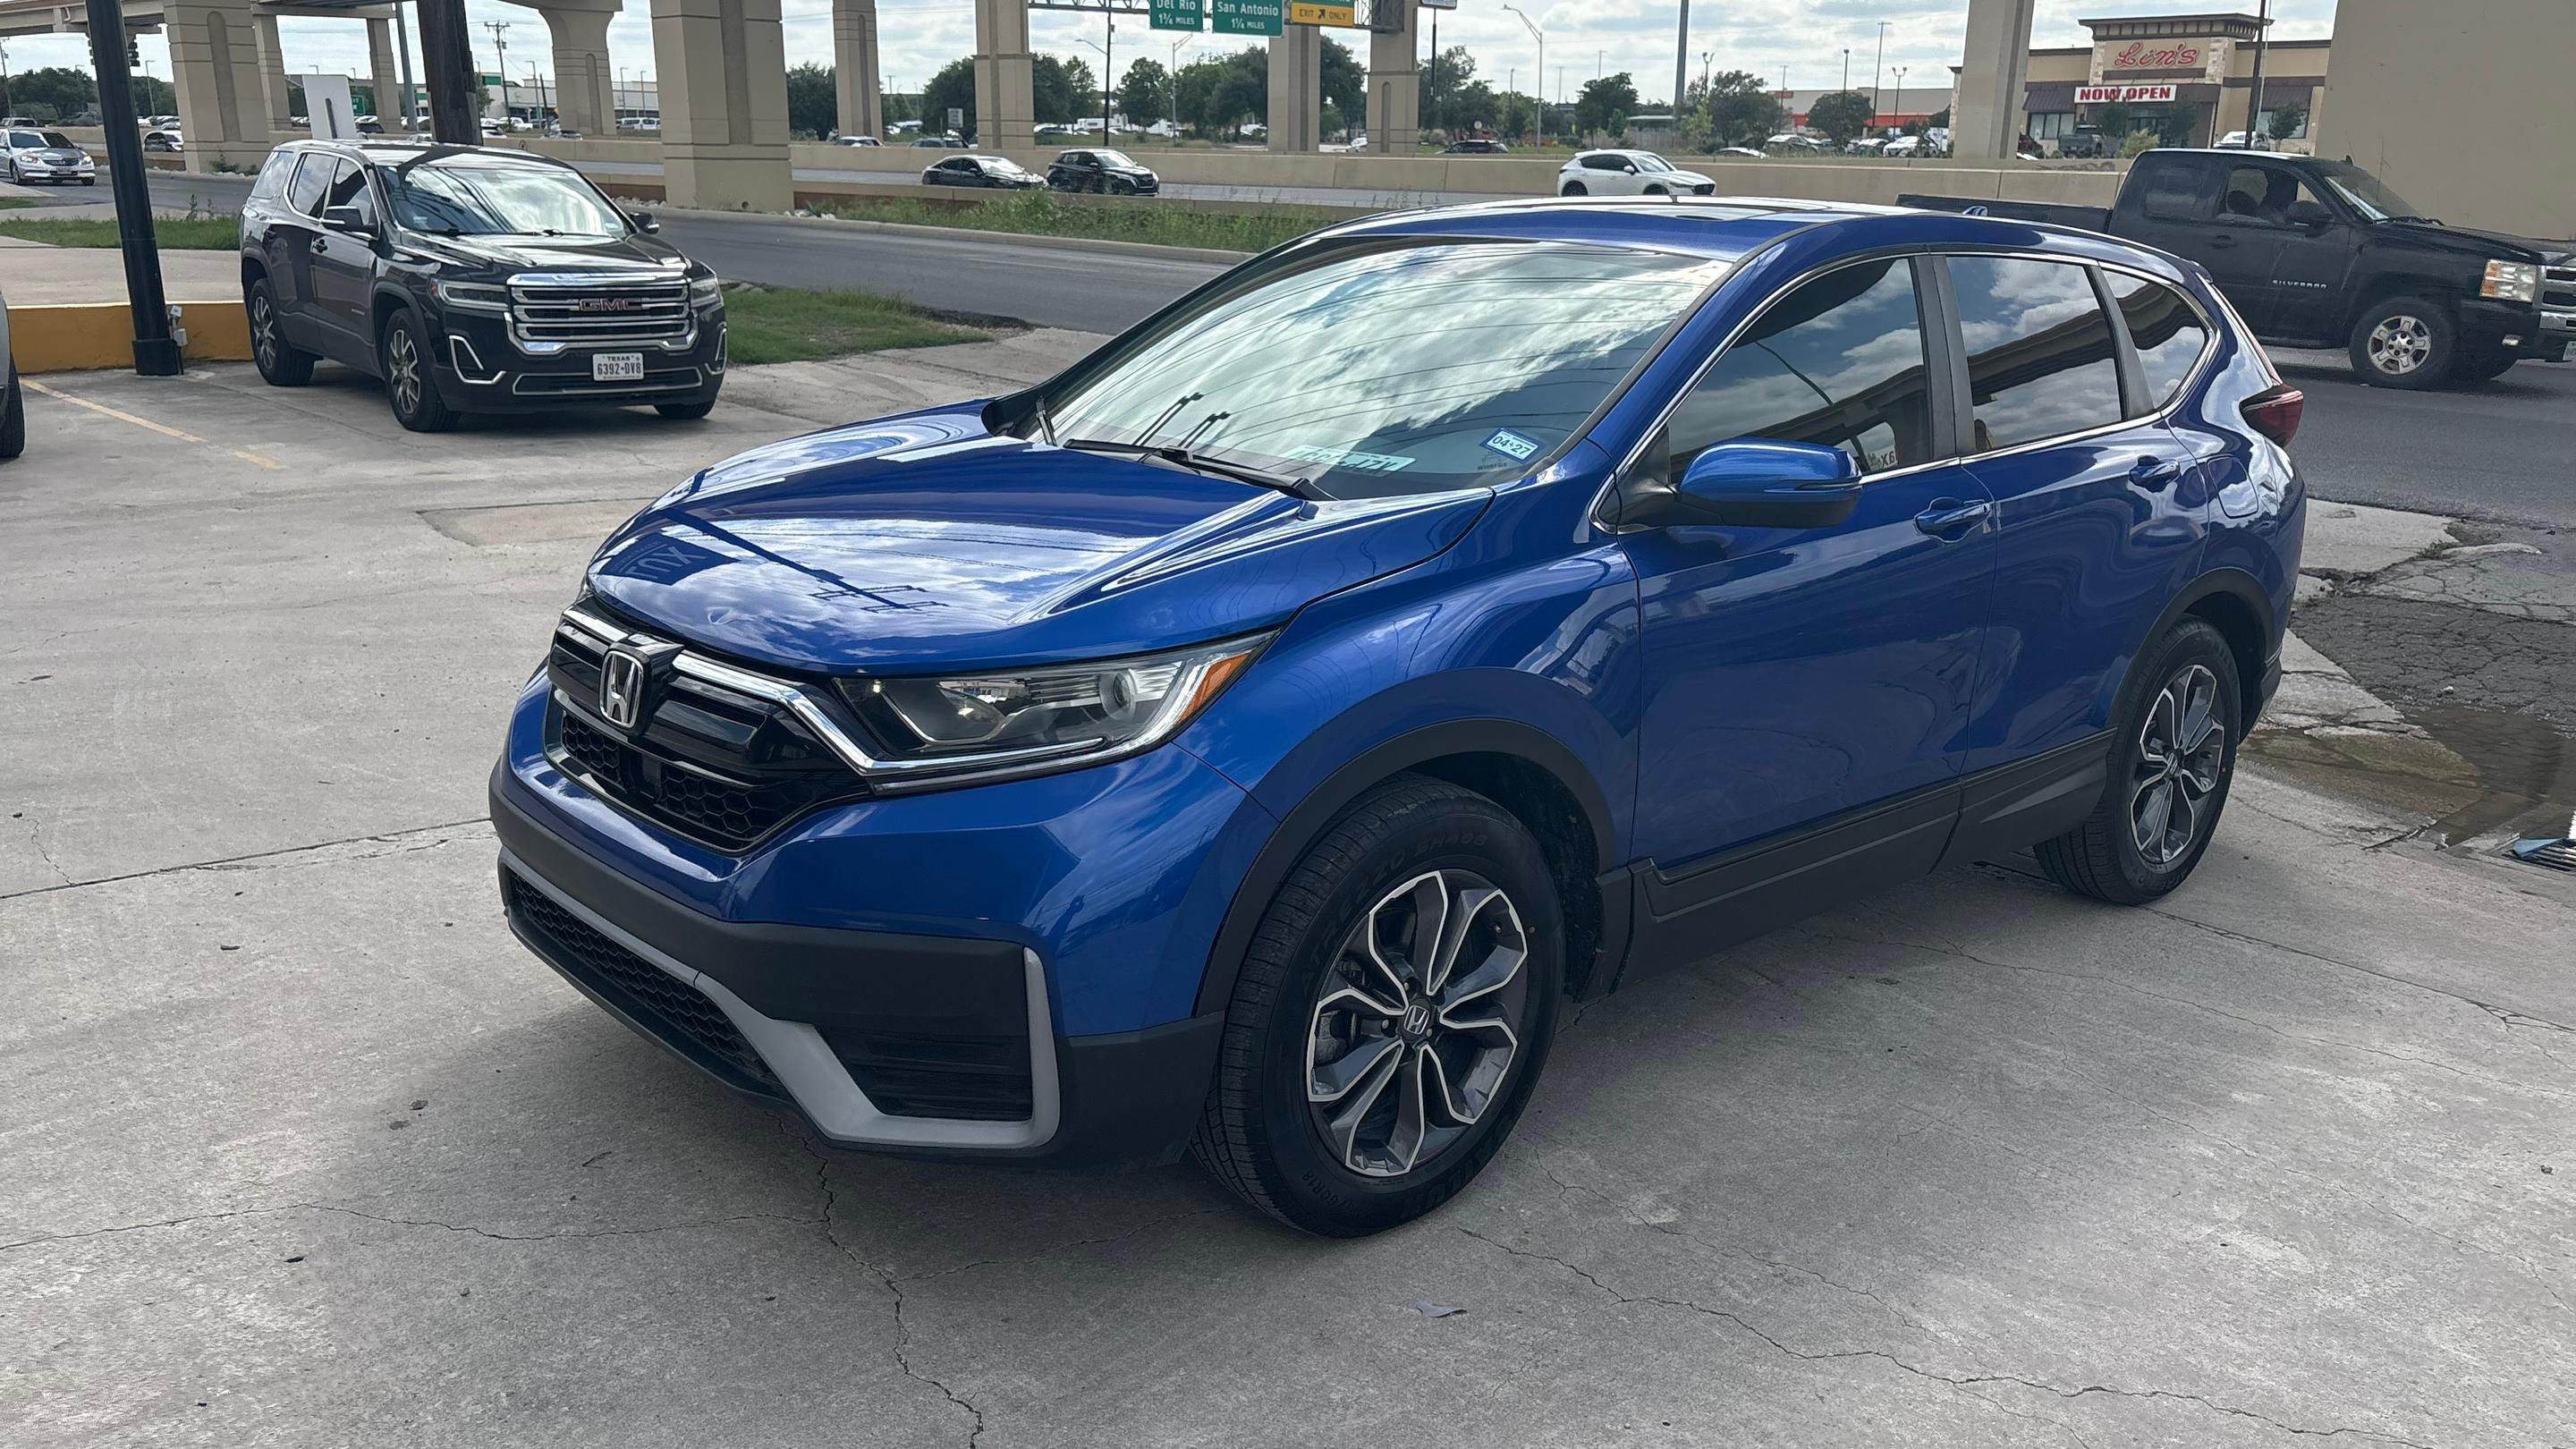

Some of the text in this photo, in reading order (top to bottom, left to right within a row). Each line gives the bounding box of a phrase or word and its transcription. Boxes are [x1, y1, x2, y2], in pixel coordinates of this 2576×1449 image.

[1180, 0, 1196, 11] Rio
[1217, 2, 1279, 16] San Antonio
[1175, 17, 1195, 25] MILES
[2114, 42, 2199, 67] Lin's
[2080, 87, 2171, 100] NOW OPEN
[580, 300, 642, 310] GMC
